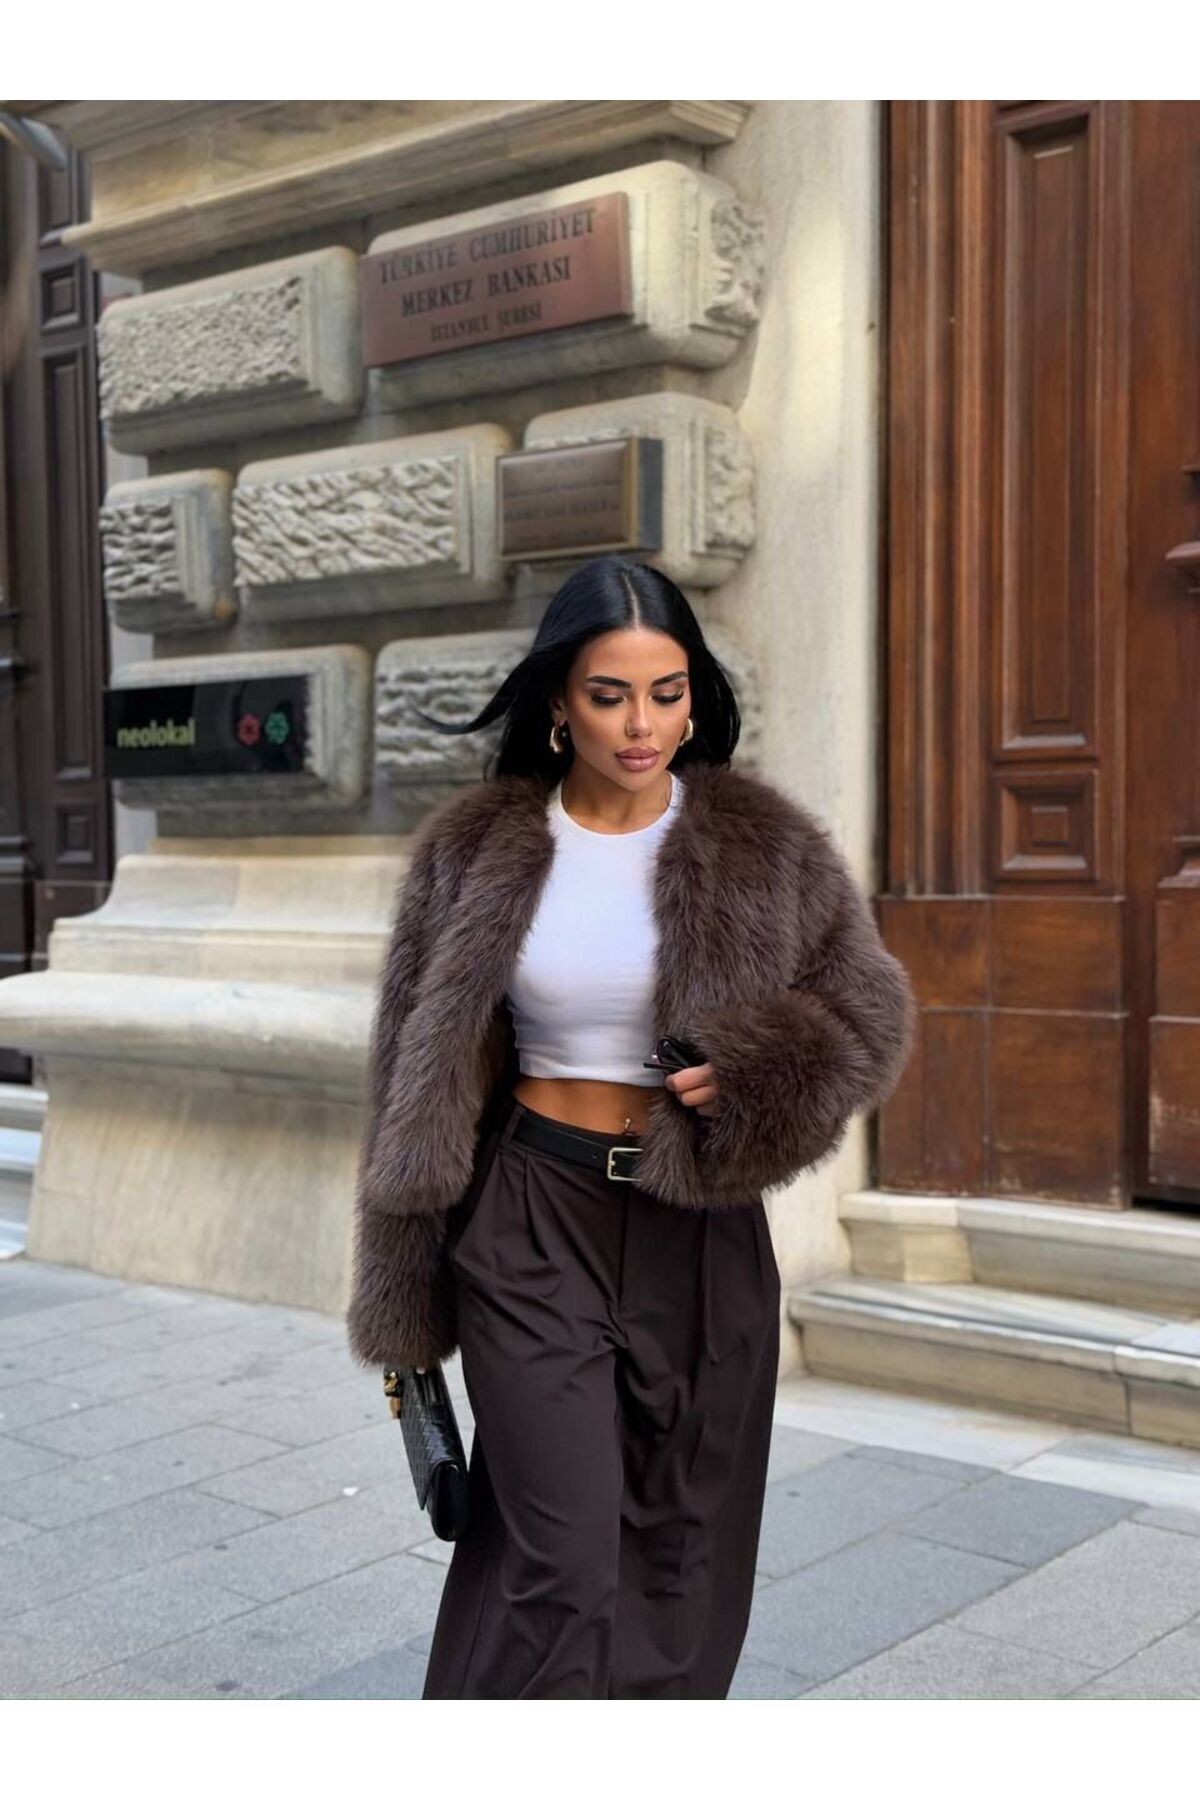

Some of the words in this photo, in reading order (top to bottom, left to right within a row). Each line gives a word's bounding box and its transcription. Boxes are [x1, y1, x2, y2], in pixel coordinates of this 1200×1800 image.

[469, 208, 596, 261] CUMHURİYET
[402, 279, 475, 317] MERKEZ
[488, 256, 571, 297] BANKASI
[117, 717, 196, 748] neolokal
